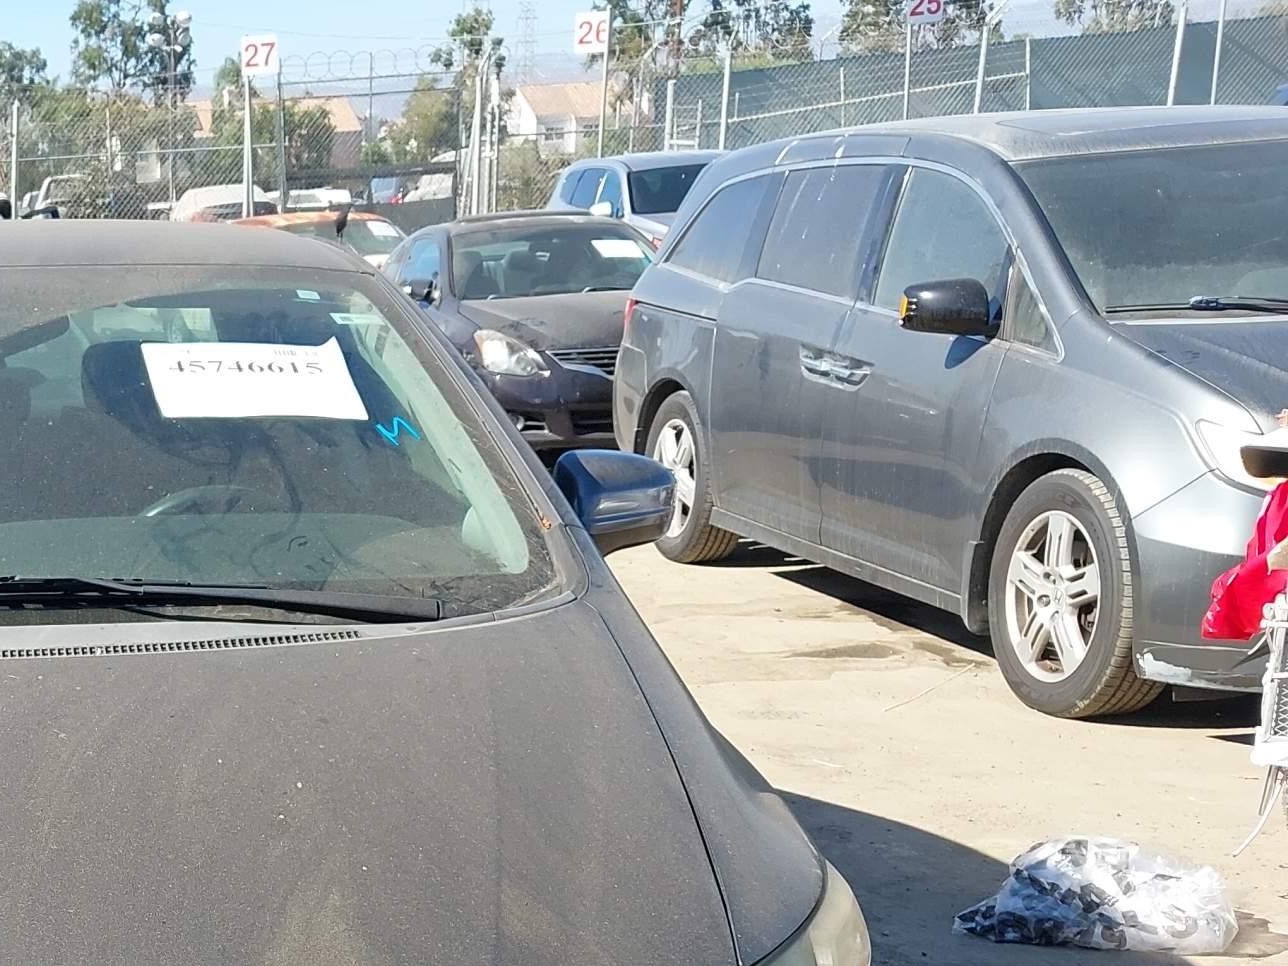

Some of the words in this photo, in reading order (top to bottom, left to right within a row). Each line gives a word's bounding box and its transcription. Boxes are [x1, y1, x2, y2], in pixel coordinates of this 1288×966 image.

[909, 0, 941, 16] 25
[578, 20, 607, 44] 26
[245, 42, 275, 67] 27
[169, 360, 323, 375] 45746615
